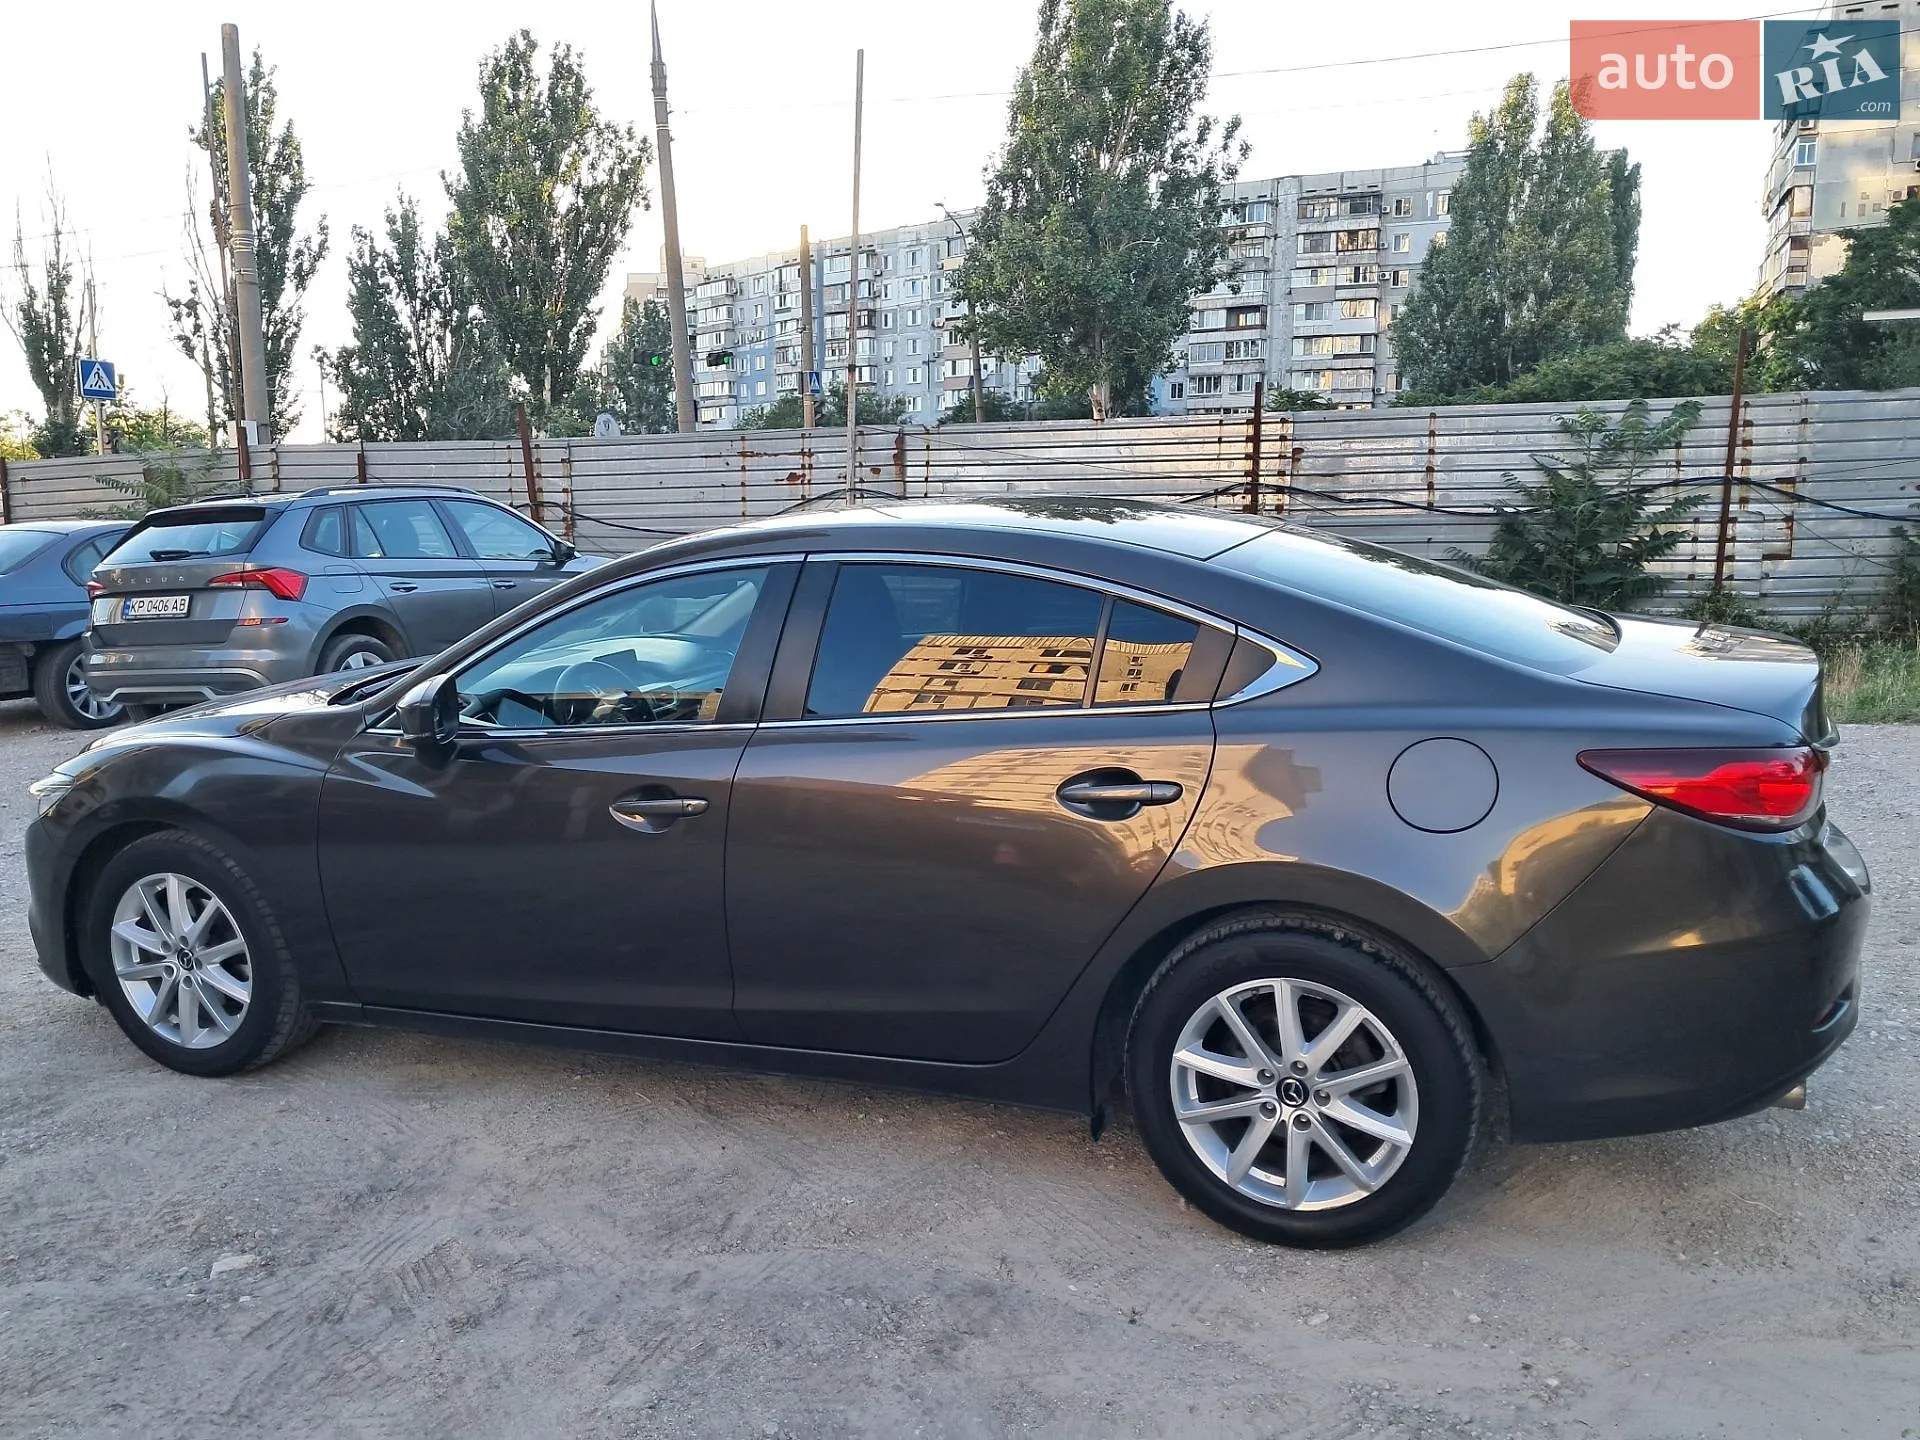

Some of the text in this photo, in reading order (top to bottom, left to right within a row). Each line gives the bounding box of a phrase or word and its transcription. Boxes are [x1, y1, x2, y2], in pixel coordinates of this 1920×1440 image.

[131, 600, 145, 613] KP
[146, 599, 169, 613] 0406
[171, 598, 187, 612] AB
